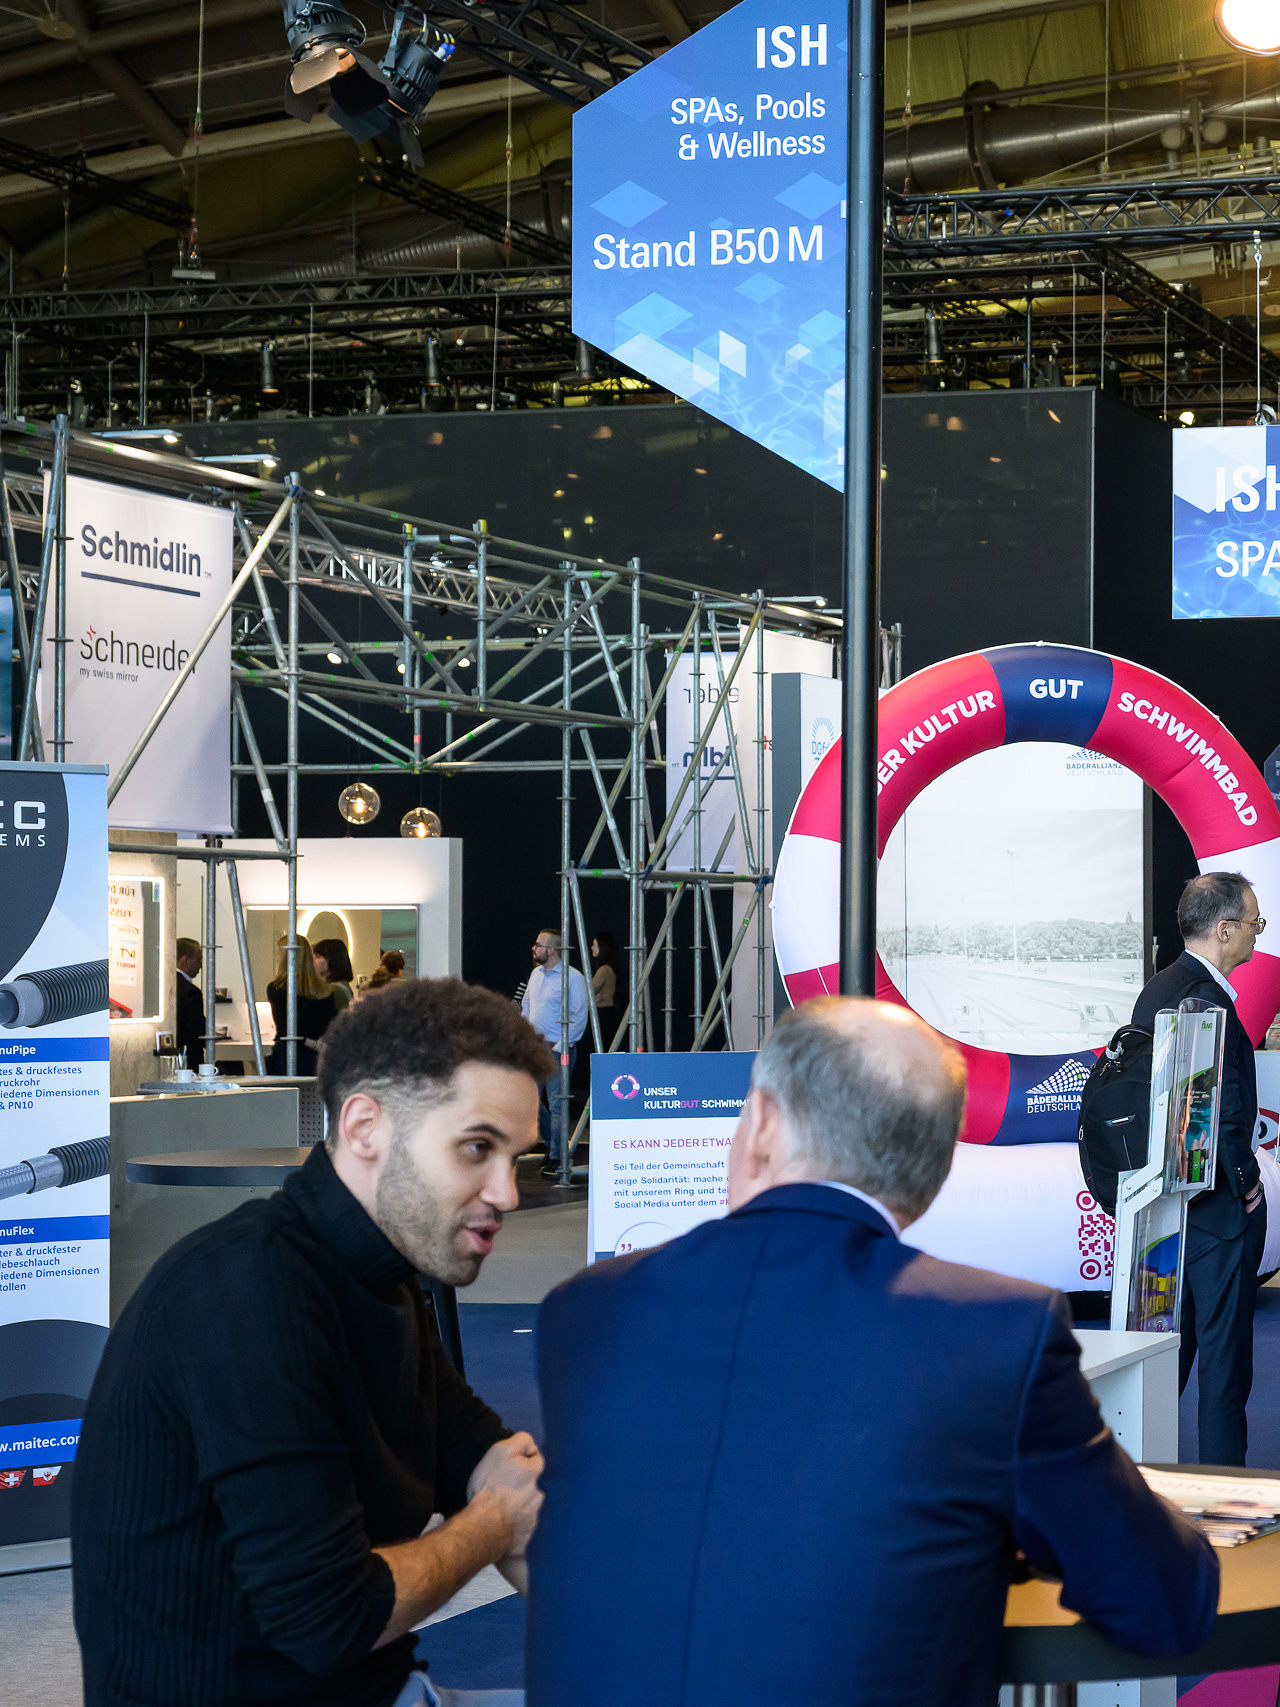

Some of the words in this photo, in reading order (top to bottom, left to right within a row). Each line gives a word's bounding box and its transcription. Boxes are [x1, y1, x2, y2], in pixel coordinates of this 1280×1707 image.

[756, 24, 828, 69] ISH
[670, 97, 745, 125] SPAs,
[756, 92, 826, 121] Pools
[678, 134, 699, 161] &
[707, 131, 826, 159] Wellness
[593, 231, 696, 270] Stand
[710, 226, 780, 266] B50
[788, 225, 823, 262] M
[81, 524, 201, 577] Schmidlin
[80, 629, 196, 674] Schneide
[79, 667, 91, 679] my
[92, 667, 114, 680] swiss
[115, 670, 139, 683] mirror
[1028, 678, 1084, 700] GUT
[900, 690, 996, 756] KULTUR
[1116, 691, 1259, 827] SCHWIMMBAD
[0, 801, 46, 830] C
[15, 1067, 23, 1076] &
[26, 1065, 82, 1075] druckfestes
[35, 1087, 100, 1098] Dimensionen
[643, 1087, 678, 1097] UNSER
[8, 1100, 34, 1110] PN10
[643, 1100, 700, 1110] KULTURGUT
[701, 1099, 749, 1109] SCHWIMM
[613, 1140, 628, 1149] ES
[629, 1139, 661, 1149] KANN
[663, 1138, 700, 1148] JEDER
[613, 1163, 627, 1171] Sei
[629, 1162, 644, 1171] Teil
[646, 1162, 661, 1170] der
[663, 1161, 725, 1170] Gemeinschaft
[614, 1177, 638, 1186] zeige
[641, 1175, 690, 1185] Solidarität:
[693, 1175, 723, 1183] mache
[614, 1189, 629, 1197] mit
[674, 1187, 695, 1196] Ring
[697, 1187, 715, 1195] und
[614, 1200, 642, 1209] Social
[643, 1200, 670, 1208] Media
[671, 1200, 696, 1208] unter
[697, 1199, 717, 1207] dem
[15, 1248, 23, 1257] &
[26, 1245, 81, 1256] druckfester
[35, 1267, 100, 1278] Dimensionen
